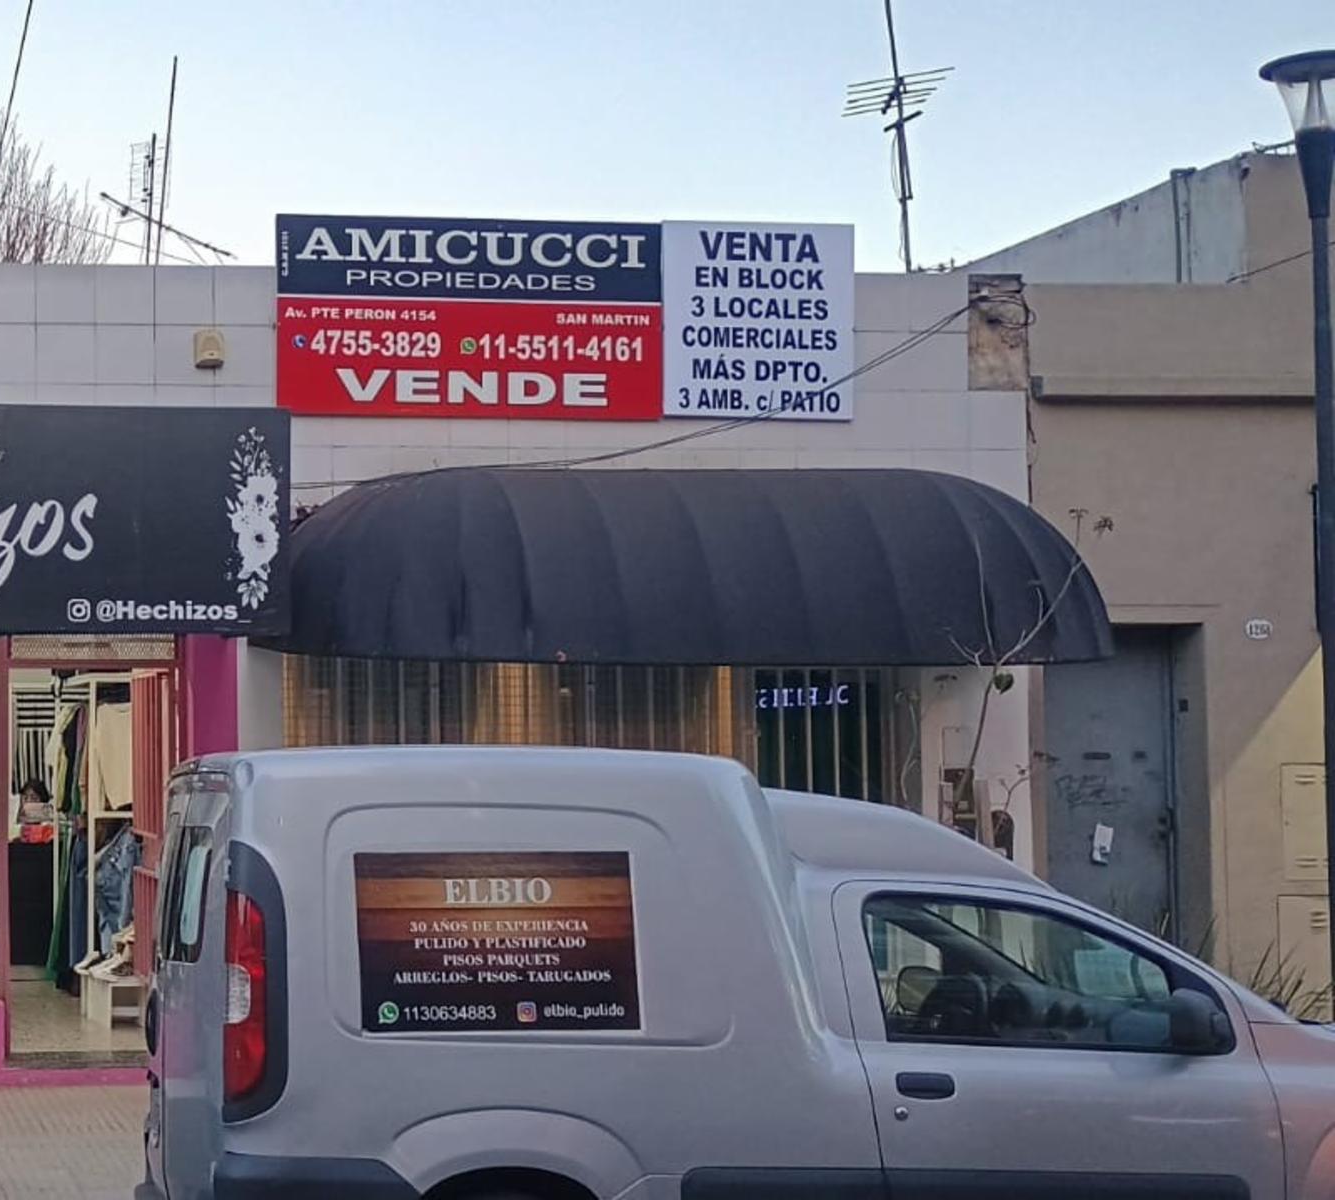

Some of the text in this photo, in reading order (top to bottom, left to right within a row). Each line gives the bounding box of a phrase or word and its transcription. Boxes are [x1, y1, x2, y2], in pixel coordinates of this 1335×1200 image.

[295, 227, 647, 269] AMICUCCI
[699, 230, 820, 263] VENTA
[346, 270, 596, 292] PROPIEDADES
[695, 266, 824, 291] EN BLOCK
[285, 307, 437, 321] Av. PTE PERON 4154
[556, 313, 650, 326] SAN MARTIN
[691, 295, 829, 320] 3 LOCALES
[310, 329, 442, 358] 4755-3829
[479, 333, 643, 361] 11-5511-4161
[682, 326, 838, 351] COMERCIALES
[692, 353, 828, 384] MÁS DPTO.
[335, 368, 609, 407] VENDE
[679, 387, 690, 409] 3
[697, 388, 749, 410] AMB.
[780, 390, 841, 413] PATIO
[95, 600, 252, 624] @Hechizos_
[443, 877, 552, 905] ELBIO
[409, 918, 589, 932] 30 AÑOS DE EXPERIENCIA
[415, 936, 586, 949] PULIDO Y PLASTIFICADO
[443, 953, 561, 968] PISOS PARQUETS
[393, 970, 612, 984] ARREGLOS- PISOS- TARUGADOS
[403, 1006, 497, 1021] 1130634883
[543, 1003, 625, 1020] elbio_pulido
